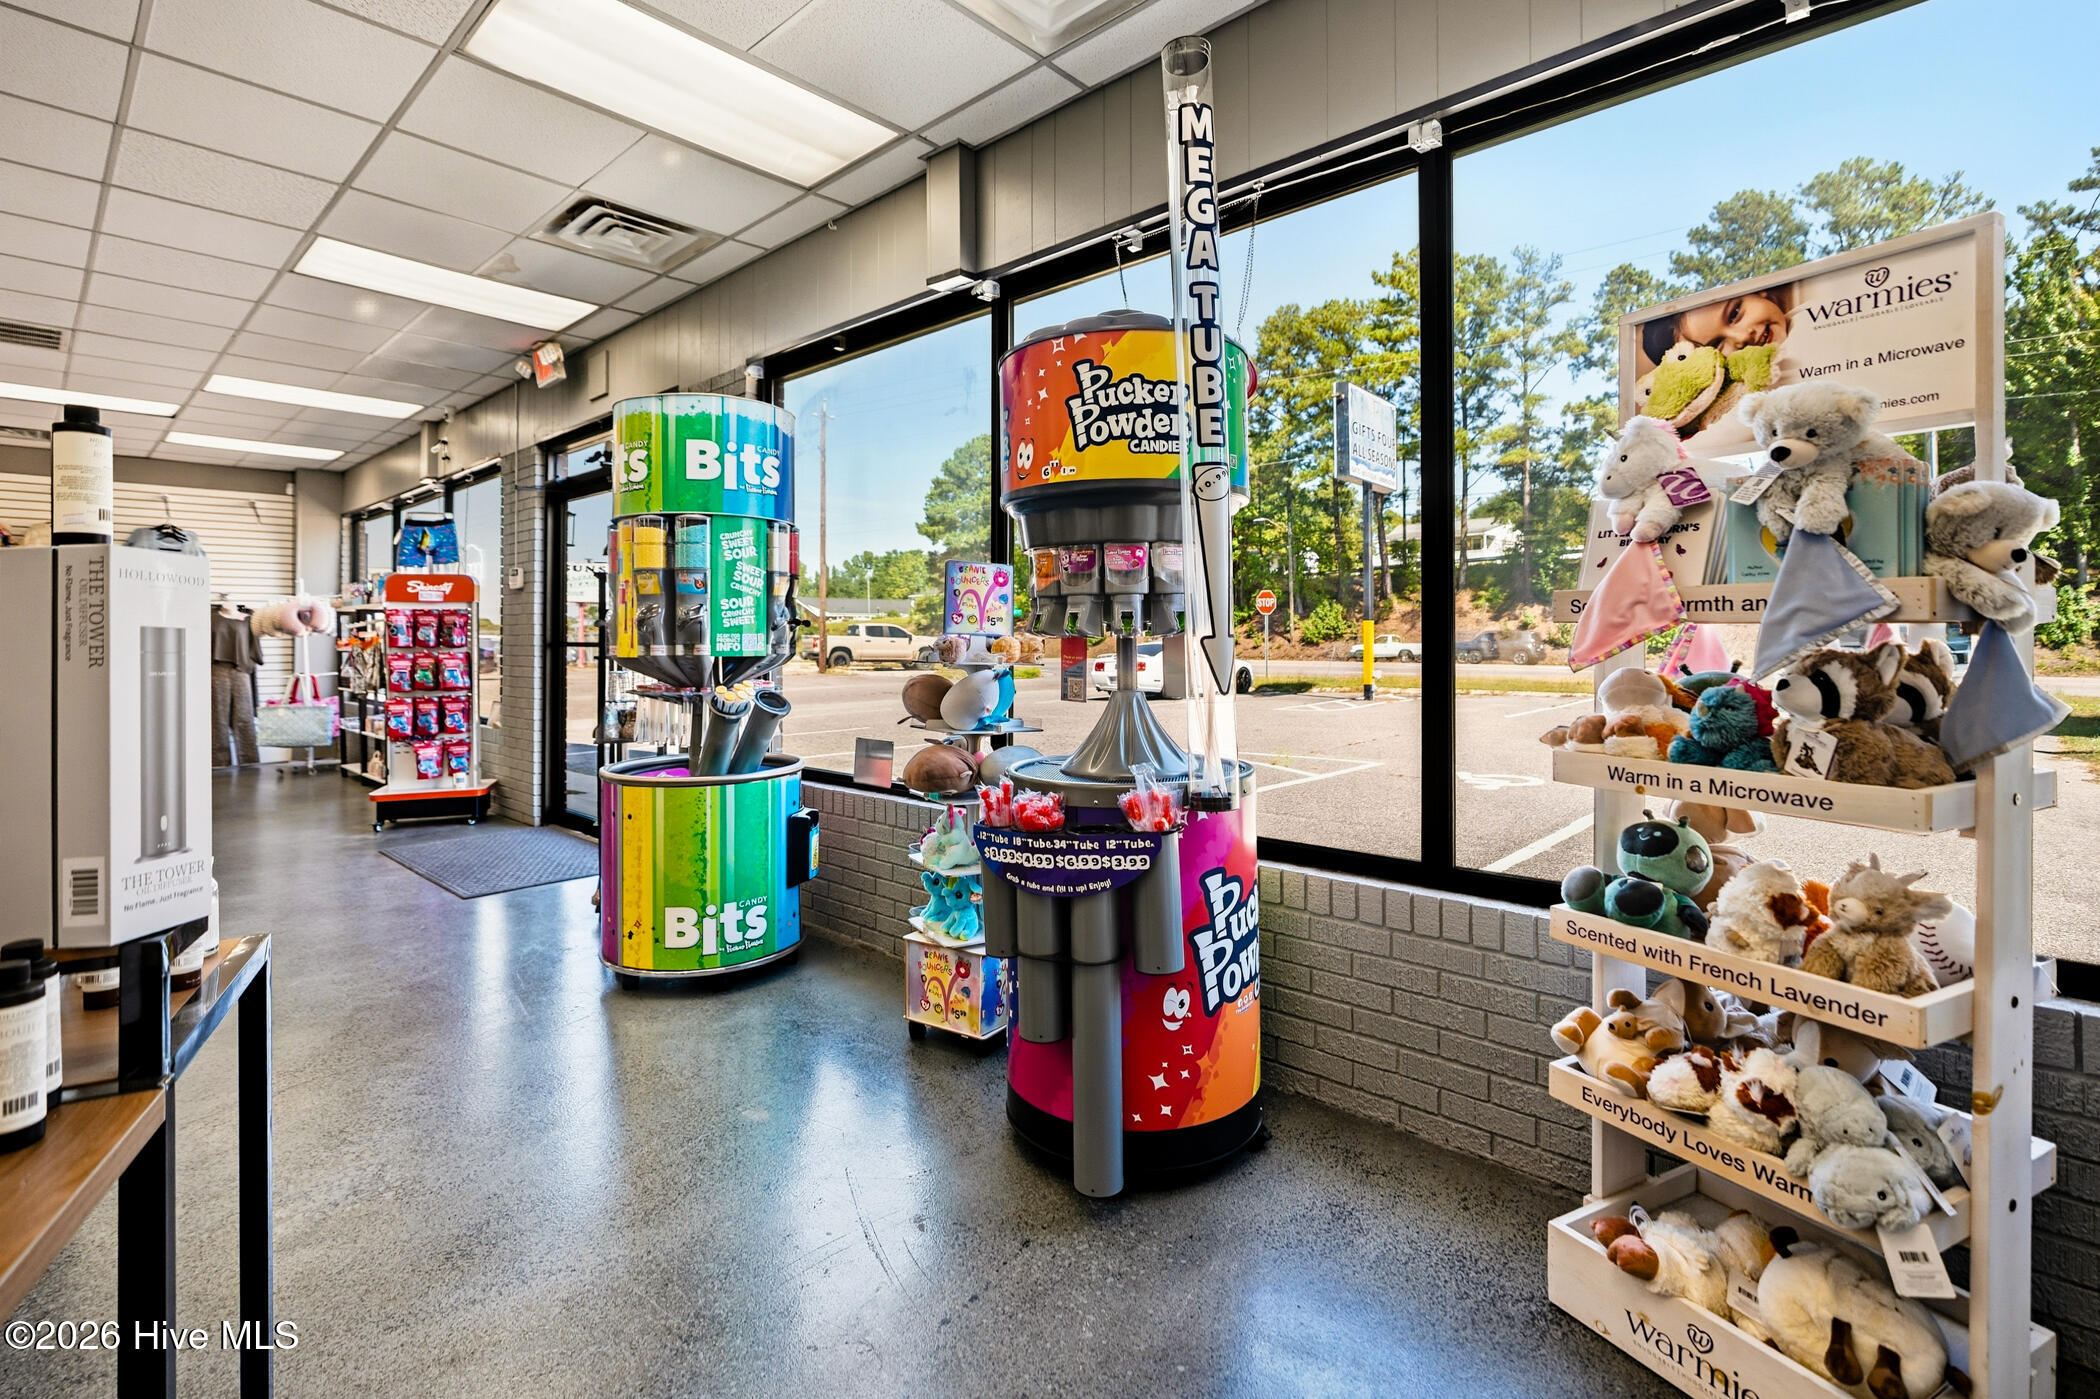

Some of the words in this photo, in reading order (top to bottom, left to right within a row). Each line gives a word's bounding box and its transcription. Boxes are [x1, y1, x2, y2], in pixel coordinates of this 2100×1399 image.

[1180, 104, 1218, 270] MEGA
[1190, 282, 1224, 446] TUBE
[1799, 361, 1841, 379] Warm
[1846, 357, 1859, 370] in
[1863, 356, 1873, 366] a
[1877, 336, 1966, 364] Microwave
[1352, 421, 1376, 442] GIFTS
[757, 445, 780, 456] CANDY
[1352, 442, 1366, 459] ALL
[686, 438, 781, 490] Bits
[1198, 470, 1227, 493] 10.99
[724, 546, 758, 561] SOUR
[89, 556, 104, 595] THE
[732, 570, 765, 589] SOUR
[720, 595, 755, 610] SOUR
[1256, 597, 1275, 607] STOP
[89, 601, 104, 669] TOWER
[716, 642, 741, 651] INFO
[1608, 765, 1660, 788] Warm
[1666, 772, 1683, 790] in
[1689, 781, 1702, 794] a
[1708, 778, 1834, 812] Microwave
[1016, 850, 1055, 869] $4.99
[1056, 854, 1101, 870] $6.99
[1101, 855, 1150, 871] $3.99
[121, 871, 153, 891] THE
[155, 859, 205, 883] TOWER
[1042, 884, 1055, 893] and
[1088, 878, 1112, 891] Enjoy!
[739, 896, 768, 908] CANDY
[664, 902, 768, 956] Bits
[1565, 919, 1637, 955] Scented
[1642, 944, 1683, 969] with
[1689, 954, 1763, 992] French
[1770, 977, 1889, 1029] Lavender
[1581, 1086, 1677, 1144] Everybody
[1683, 1130, 1747, 1174] Loves
